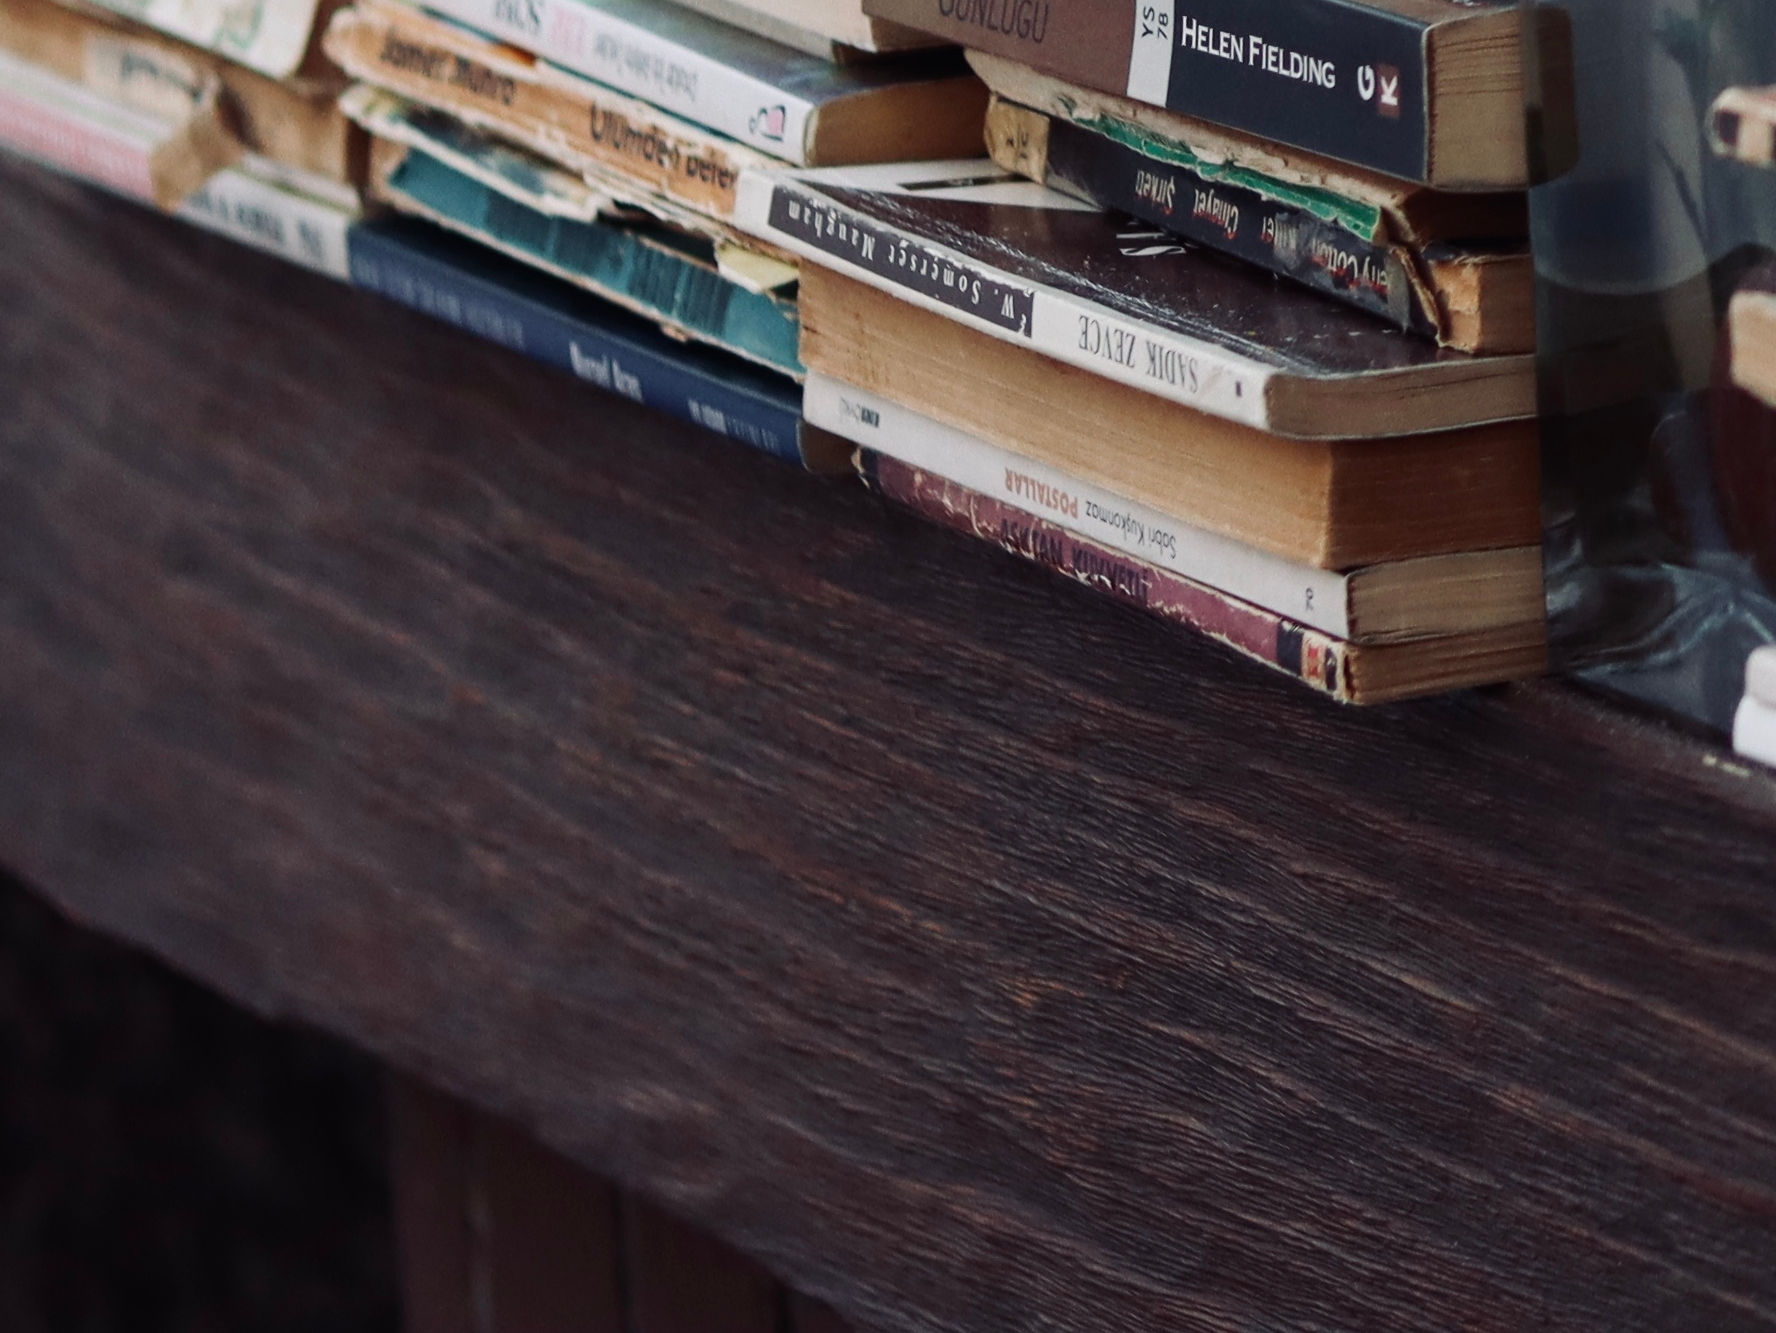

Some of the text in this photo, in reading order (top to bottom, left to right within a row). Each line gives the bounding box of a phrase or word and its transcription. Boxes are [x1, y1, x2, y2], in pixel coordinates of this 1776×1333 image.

[1181, 15, 1336, 89] HELEN FIELDING
[788, 199, 876, 261] Maugham
[888, 239, 982, 305] Somerset
[1078, 314, 1199, 393] SADIK ZEVCE
[1004, 467, 1177, 560] Sabri Kuşkonmaz POSTALLAR
